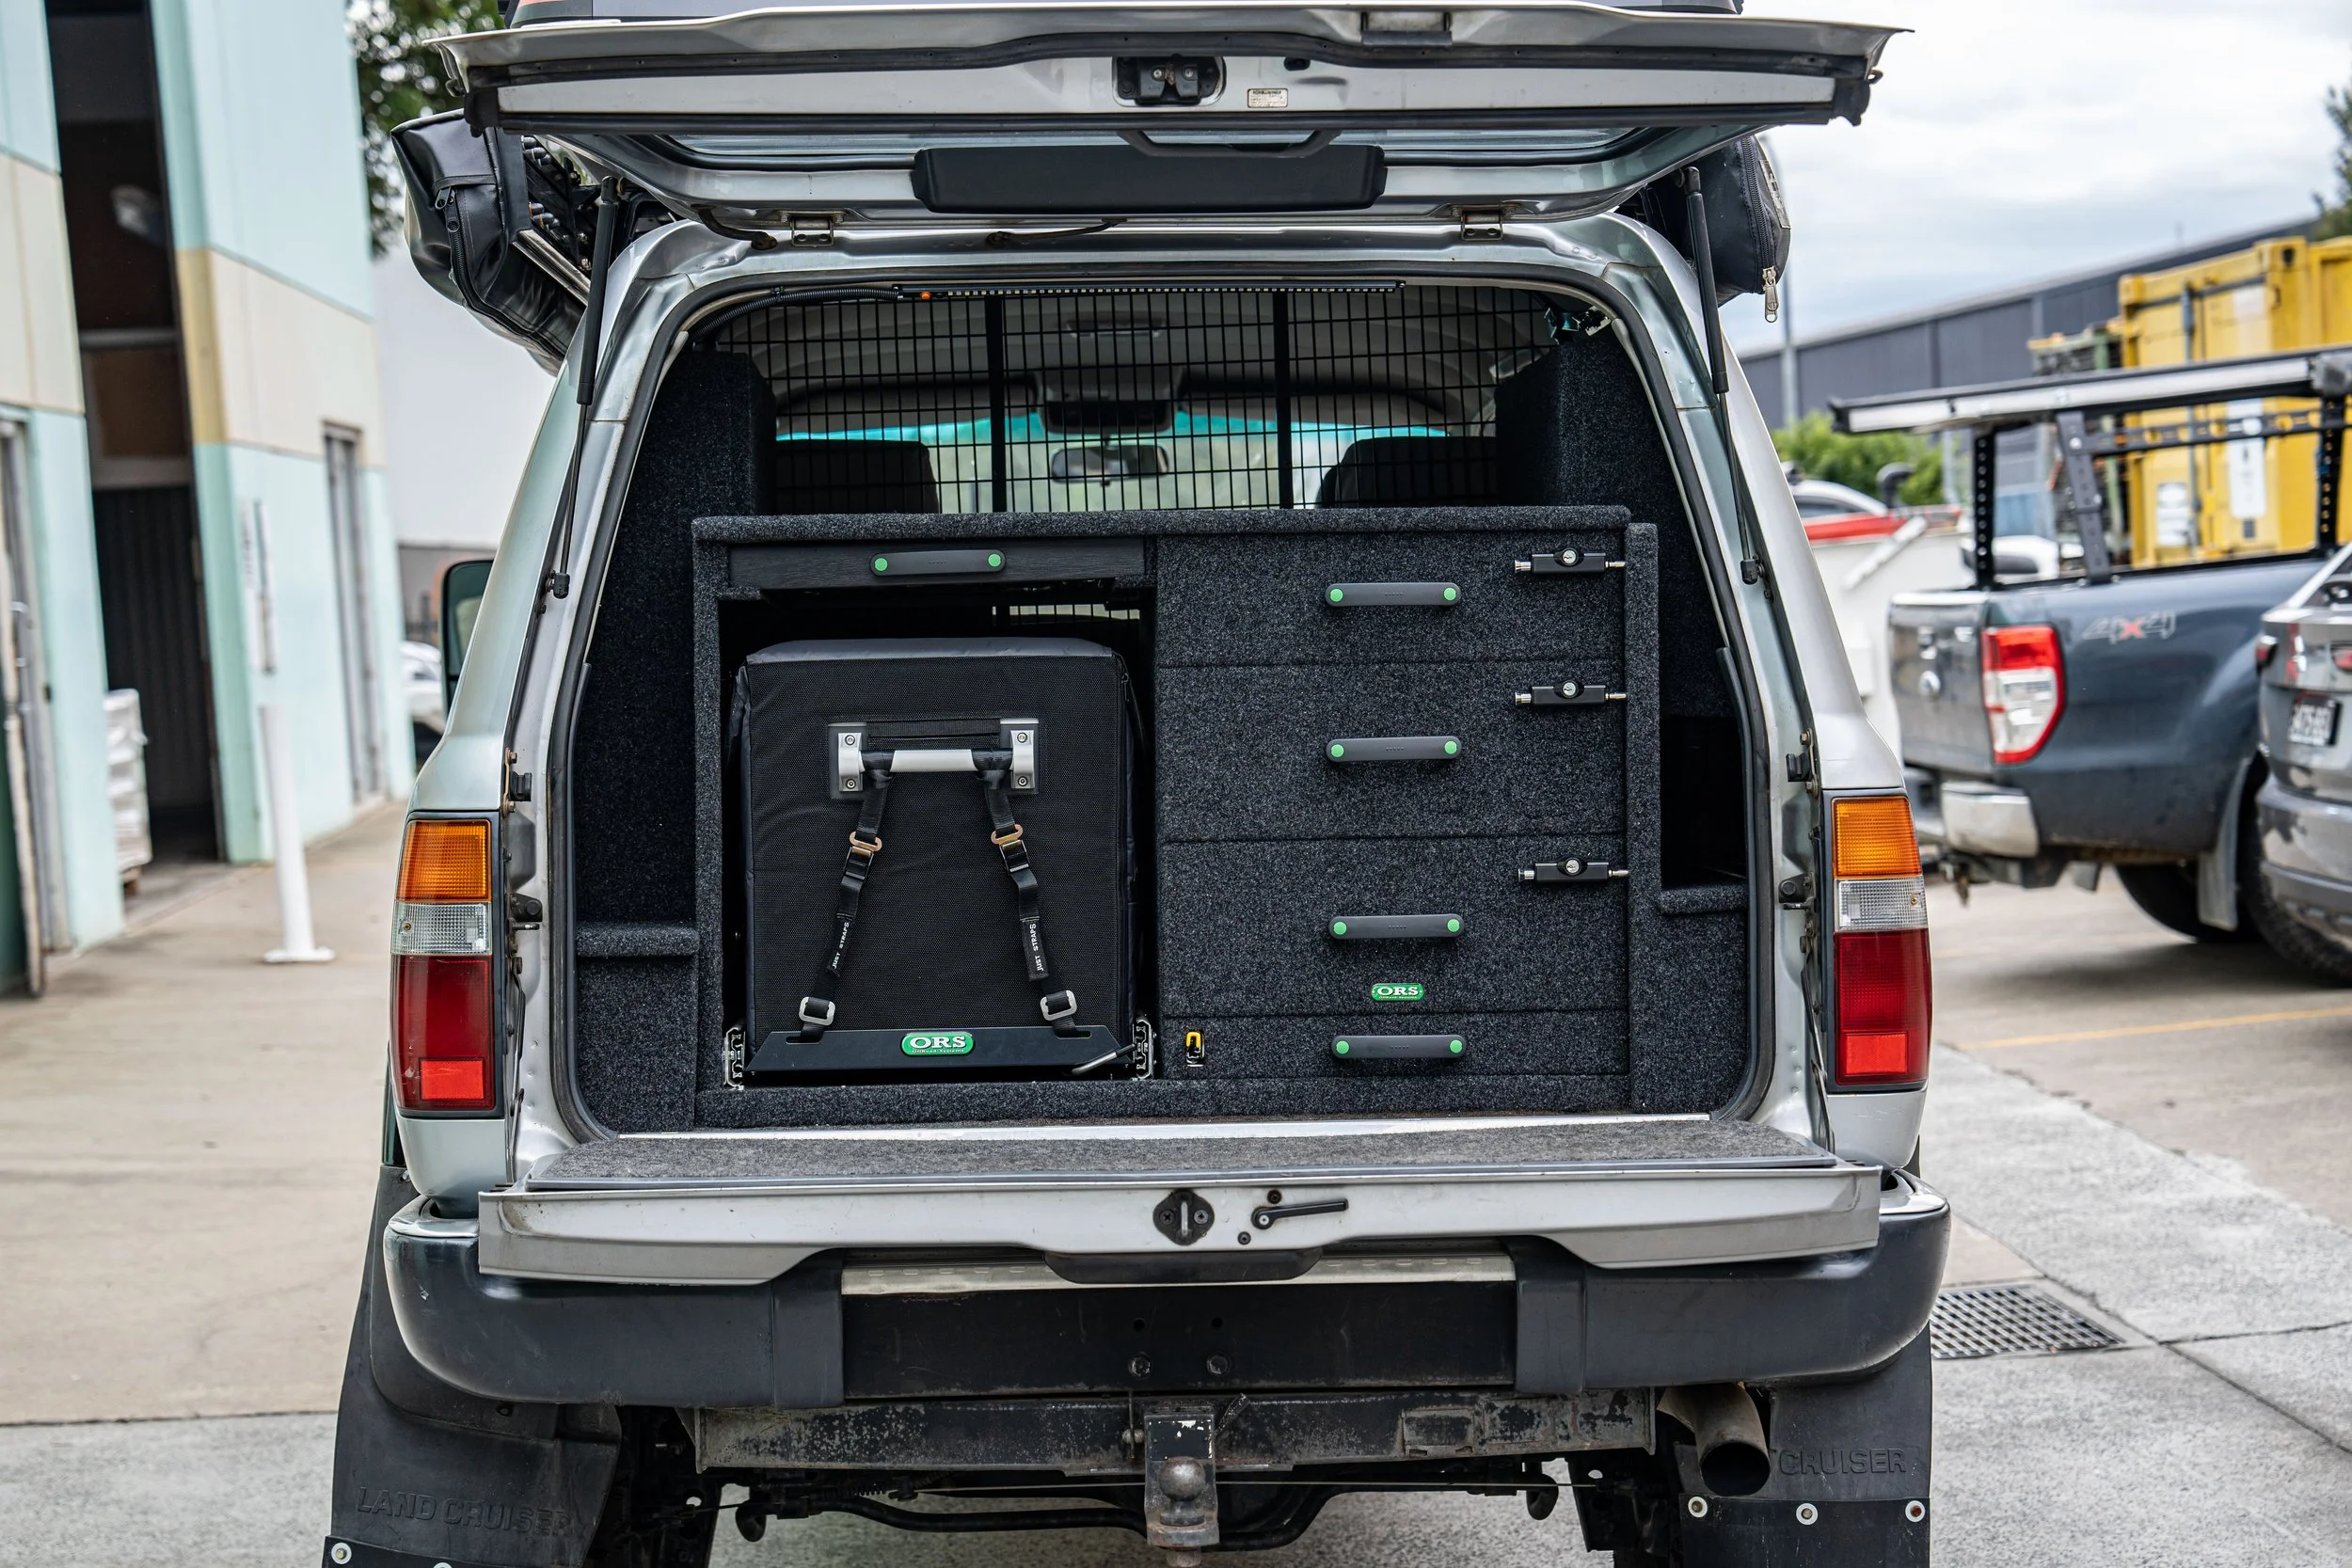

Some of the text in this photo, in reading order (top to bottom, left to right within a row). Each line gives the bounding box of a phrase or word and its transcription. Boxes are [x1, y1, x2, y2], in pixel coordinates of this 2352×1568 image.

[1029, 923, 1044, 972] JUST STRAPS
[832, 951, 840, 970] JUST
[1376, 987, 1419, 996] ORS
[909, 1036, 966, 1049] ORS
[1779, 1448, 1907, 1476] CRUISER
[358, 1487, 573, 1538] LAND CRUISER
